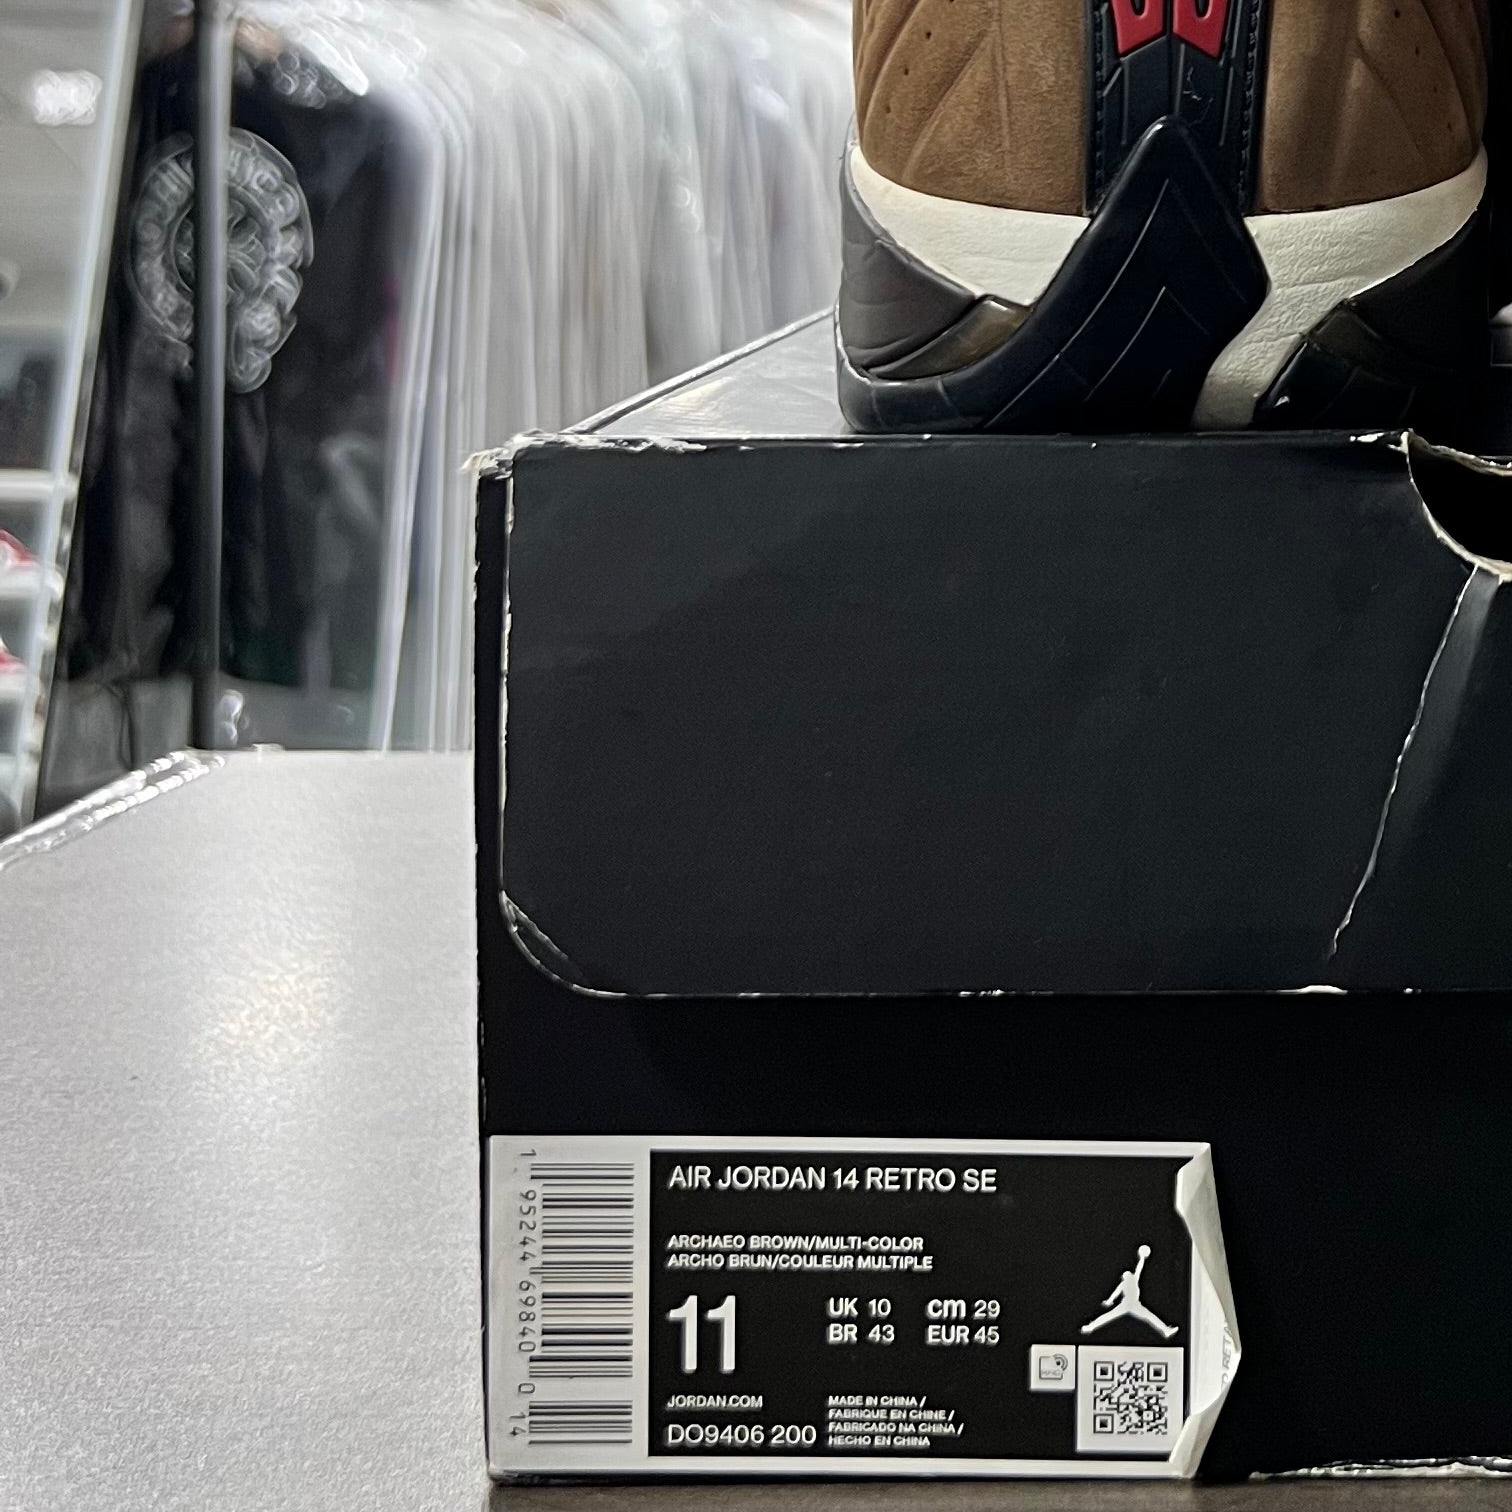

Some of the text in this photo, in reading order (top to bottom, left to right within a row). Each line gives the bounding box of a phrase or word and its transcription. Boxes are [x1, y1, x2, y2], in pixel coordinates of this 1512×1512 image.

[668, 1165, 997, 1193] AIR JORDAN 14 RETRO SE
[519, 1189, 537, 1263] 95244
[666, 1234, 924, 1252] ARCHAEO BROWN/MULTI-COLOR
[666, 1253, 934, 1272] ARCHO BRUN/COULEUR MULTIPLE
[518, 1280, 537, 1354] 69840
[828, 1296, 1001, 1320] UK 10 cm 29
[668, 1294, 736, 1374] 11
[827, 1323, 1000, 1346] BR 43 EUR 45
[666, 1395, 763, 1408] JORDAN.COM
[827, 1396, 864, 1406] MADE
[865, 1396, 879, 1406] IN
[880, 1396, 918, 1406] CHINA
[509, 1411, 527, 1437] 14
[828, 1409, 888, 1419] FABRIQUE
[889, 1409, 907, 1420] EN
[908, 1410, 947, 1420] CHINE
[770, 1424, 817, 1447] 200
[827, 1422, 897, 1432] FABRICADO
[898, 1423, 916, 1433] NA
[918, 1423, 956, 1434] CHINA
[827, 1435, 931, 1447] HECHO EN CHINA
